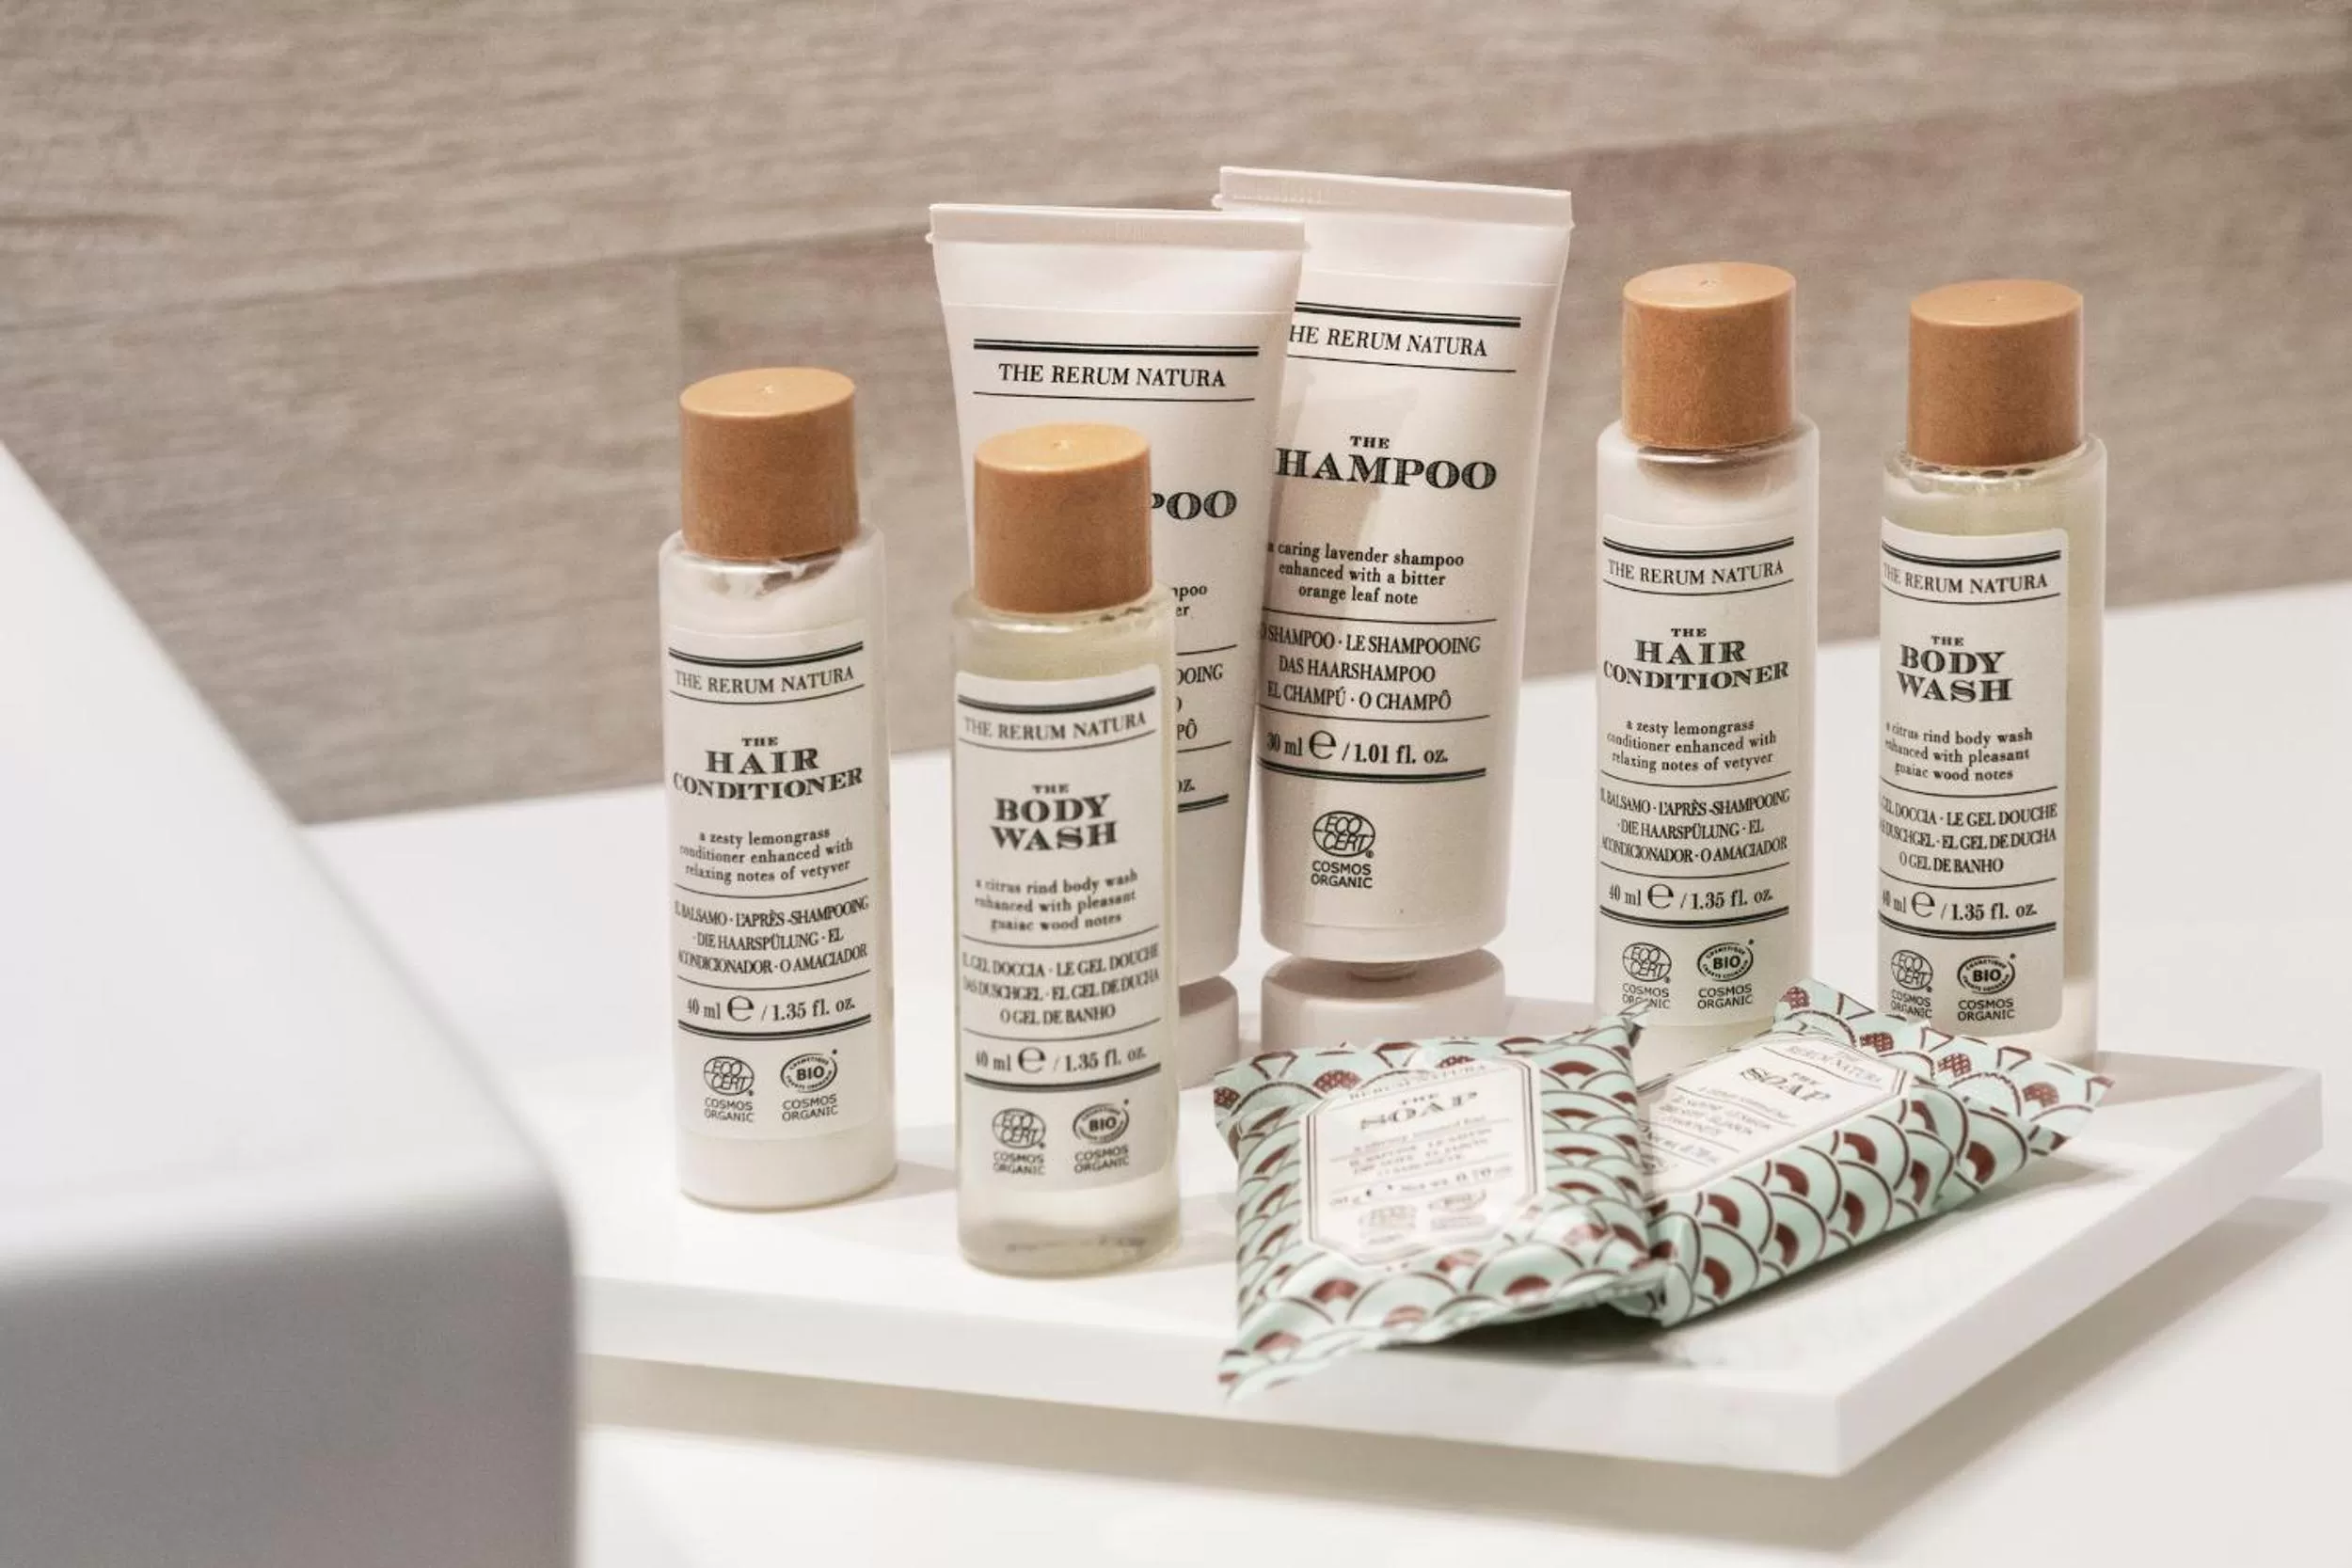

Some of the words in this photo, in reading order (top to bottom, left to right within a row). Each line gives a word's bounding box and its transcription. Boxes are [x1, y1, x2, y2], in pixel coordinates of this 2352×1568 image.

[1288, 325, 1319, 344] HE
[1327, 328, 1402, 351] RERUM
[1406, 335, 1487, 356] NATURA
[999, 363, 1043, 383] THE
[1052, 365, 1130, 386] RERUM
[1136, 368, 1226, 388] NATURA
[1349, 436, 1390, 449] THE
[1275, 447, 1497, 490] HAMPOO
[1278, 542, 1320, 562] caring
[1325, 544, 1389, 563] lavender
[1393, 548, 1464, 571] shampoo
[1279, 562, 1343, 580] enhanced
[1349, 565, 1381, 582] with
[1387, 573, 1395, 584] a
[1401, 570, 1445, 586] bitter
[1608, 559, 1634, 578] THE
[1640, 566, 1705, 585] RERUM
[1711, 560, 1784, 584] NATURA
[1904, 572, 1963, 594] RERUM
[1969, 574, 2048, 594] NATURA
[1298, 585, 1346, 604] orange
[1352, 586, 1379, 602] leaf
[1385, 589, 1418, 605] note
[1268, 624, 1335, 649] SHAMPOO
[1346, 634, 1365, 651] LE
[1368, 635, 1481, 655] SHAMPOOING
[1671, 627, 1707, 638] THE
[1931, 635, 1964, 646] THE
[1634, 639, 1746, 665] HAIR
[1899, 643, 2006, 674] BODY
[1279, 655, 1303, 673] DAS
[1307, 659, 1436, 682] HAARSHAMPOO
[1603, 659, 1789, 690] CONDITIONER
[675, 670, 703, 689] THE
[707, 675, 774, 694] RERUM
[781, 666, 854, 692] NATURA
[1897, 670, 2013, 703] WASH
[1268, 681, 1280, 698] EL
[1283, 684, 1345, 706] CHAMPÚ
[1359, 691, 1372, 706] O
[1375, 689, 1452, 710] CHAMPÔ
[964, 716, 993, 737] THE
[998, 723, 1066, 741] RERUM
[1073, 711, 1147, 738] NATURA
[1637, 721, 1669, 738] zesty
[1674, 720, 1755, 736] lemongrass
[1892, 722, 1918, 739] citrus
[1923, 730, 1950, 745] rind
[1955, 731, 1991, 749] body
[1996, 727, 2033, 743] wash
[741, 736, 778, 747] THE
[1266, 732, 1280, 752] 30
[1284, 737, 1303, 756] ml
[1354, 744, 1390, 764] 1.01
[1396, 745, 1416, 764] fl.
[1423, 749, 1448, 764] oz.
[1607, 732, 1670, 752] conditioner
[1676, 735, 1744, 752] enhanced
[1749, 730, 1776, 747] with
[705, 747, 820, 775] HAIR
[1612, 751, 1657, 773] relaxing
[1661, 755, 1698, 771] notes
[1704, 754, 1718, 770] of
[1724, 752, 1773, 771] vetyver
[1932, 749, 1963, 763] with
[1968, 748, 2030, 768] pleasant
[673, 767, 863, 800] CONDITIONER
[1933, 768, 1969, 782] wood
[1975, 768, 2013, 781] notes
[1031, 784, 1070, 794] THE
[993, 793, 1111, 823] BODY
[1895, 801, 1936, 825] DOCCIA
[1947, 811, 1963, 826] LE
[1966, 811, 1995, 827] GEL
[1998, 802, 2058, 825] DOUCHE
[990, 820, 1118, 851] WASH
[1326, 816, 1363, 834] ECO
[1641, 822, 1740, 839] HAARSPÜLUNG
[1748, 818, 1765, 834] EL
[709, 832, 743, 849] zesty
[748, 828, 830, 847] lemongrass
[1323, 833, 1367, 851] CERT
[1712, 836, 1788, 862] AMACIADOR
[1942, 834, 1959, 850] EL
[1960, 835, 1988, 850] GEL
[1989, 834, 2008, 848] DE
[2010, 828, 2057, 848] DUCHA
[680, 845, 745, 863] conditioner
[750, 845, 820, 863] enhanced
[825, 837, 853, 856] with
[685, 863, 731, 885] relaxing
[737, 867, 775, 882] notes
[780, 866, 796, 880] of
[801, 860, 850, 879] vetyver
[1311, 861, 1372, 876] COSMOS
[1909, 853, 1931, 870] GEL
[1933, 856, 1950, 873] DE
[1953, 857, 2004, 873] BANHO
[1026, 879, 1057, 894] rind
[1063, 877, 1100, 894] body
[1105, 868, 1138, 888] wash
[1311, 874, 1373, 889] ORGANIC
[1039, 897, 1072, 912] with
[1077, 891, 1136, 914] pleasant
[1609, 883, 1621, 900] 40
[1625, 889, 1641, 906] ml
[1692, 892, 1724, 910] 1.35
[1731, 889, 1748, 907] fl.
[1754, 889, 1773, 903] oz.
[1040, 915, 1078, 930] wood
[1085, 912, 1121, 927] notes
[1951, 903, 1984, 921] 1.35
[1991, 902, 2009, 919] fl.
[2015, 903, 2037, 918] oz.
[828, 927, 844, 942] EL
[792, 942, 867, 971] AMACIADOR
[993, 960, 1045, 977] DOCCIA
[1056, 961, 1074, 976] LE
[1077, 958, 1106, 974] GEL
[1109, 942, 1159, 969] DOUCHE
[1712, 956, 1740, 970] BIO
[1051, 986, 1070, 1001] EL
[1071, 982, 1100, 999] GEL
[1102, 979, 1120, 995] DE
[1120, 968, 1159, 990] DUCHA
[1973, 968, 2001, 983] BIO
[1622, 983, 1669, 998] COSMOS
[1697, 983, 1752, 998] COSMOS
[1697, 994, 1754, 1009] ORGANIC
[1891, 989, 1931, 1007] COSMOS
[704, 1003, 721, 1020] ml
[772, 1003, 806, 1021] 1.35
[813, 998, 830, 1016] fl.
[835, 997, 855, 1012] oz.
[999, 1009, 1009, 1023] O
[1012, 1009, 1041, 1025] GEL
[1043, 1010, 1063, 1024] DE
[1066, 1003, 1116, 1024] BANHO
[1957, 1009, 2015, 1022] ORGANIC
[1958, 998, 2013, 1011] COSMOS
[993, 1054, 1011, 1071] ml
[1104, 1049, 1121, 1068] fl.
[1127, 1046, 1146, 1061] oz.
[796, 1066, 825, 1081] BIO
[705, 1097, 753, 1111] COSMOS
[783, 1093, 836, 1110] COSMOS
[704, 1108, 755, 1122] ORGANIC
[782, 1105, 838, 1121] ORGANIC
[1089, 1116, 1117, 1132] BIO
[993, 1150, 1044, 1164] COSMOS
[1073, 1157, 1130, 1173] ORGANIC
[1074, 1145, 1129, 1163] COSMOS
